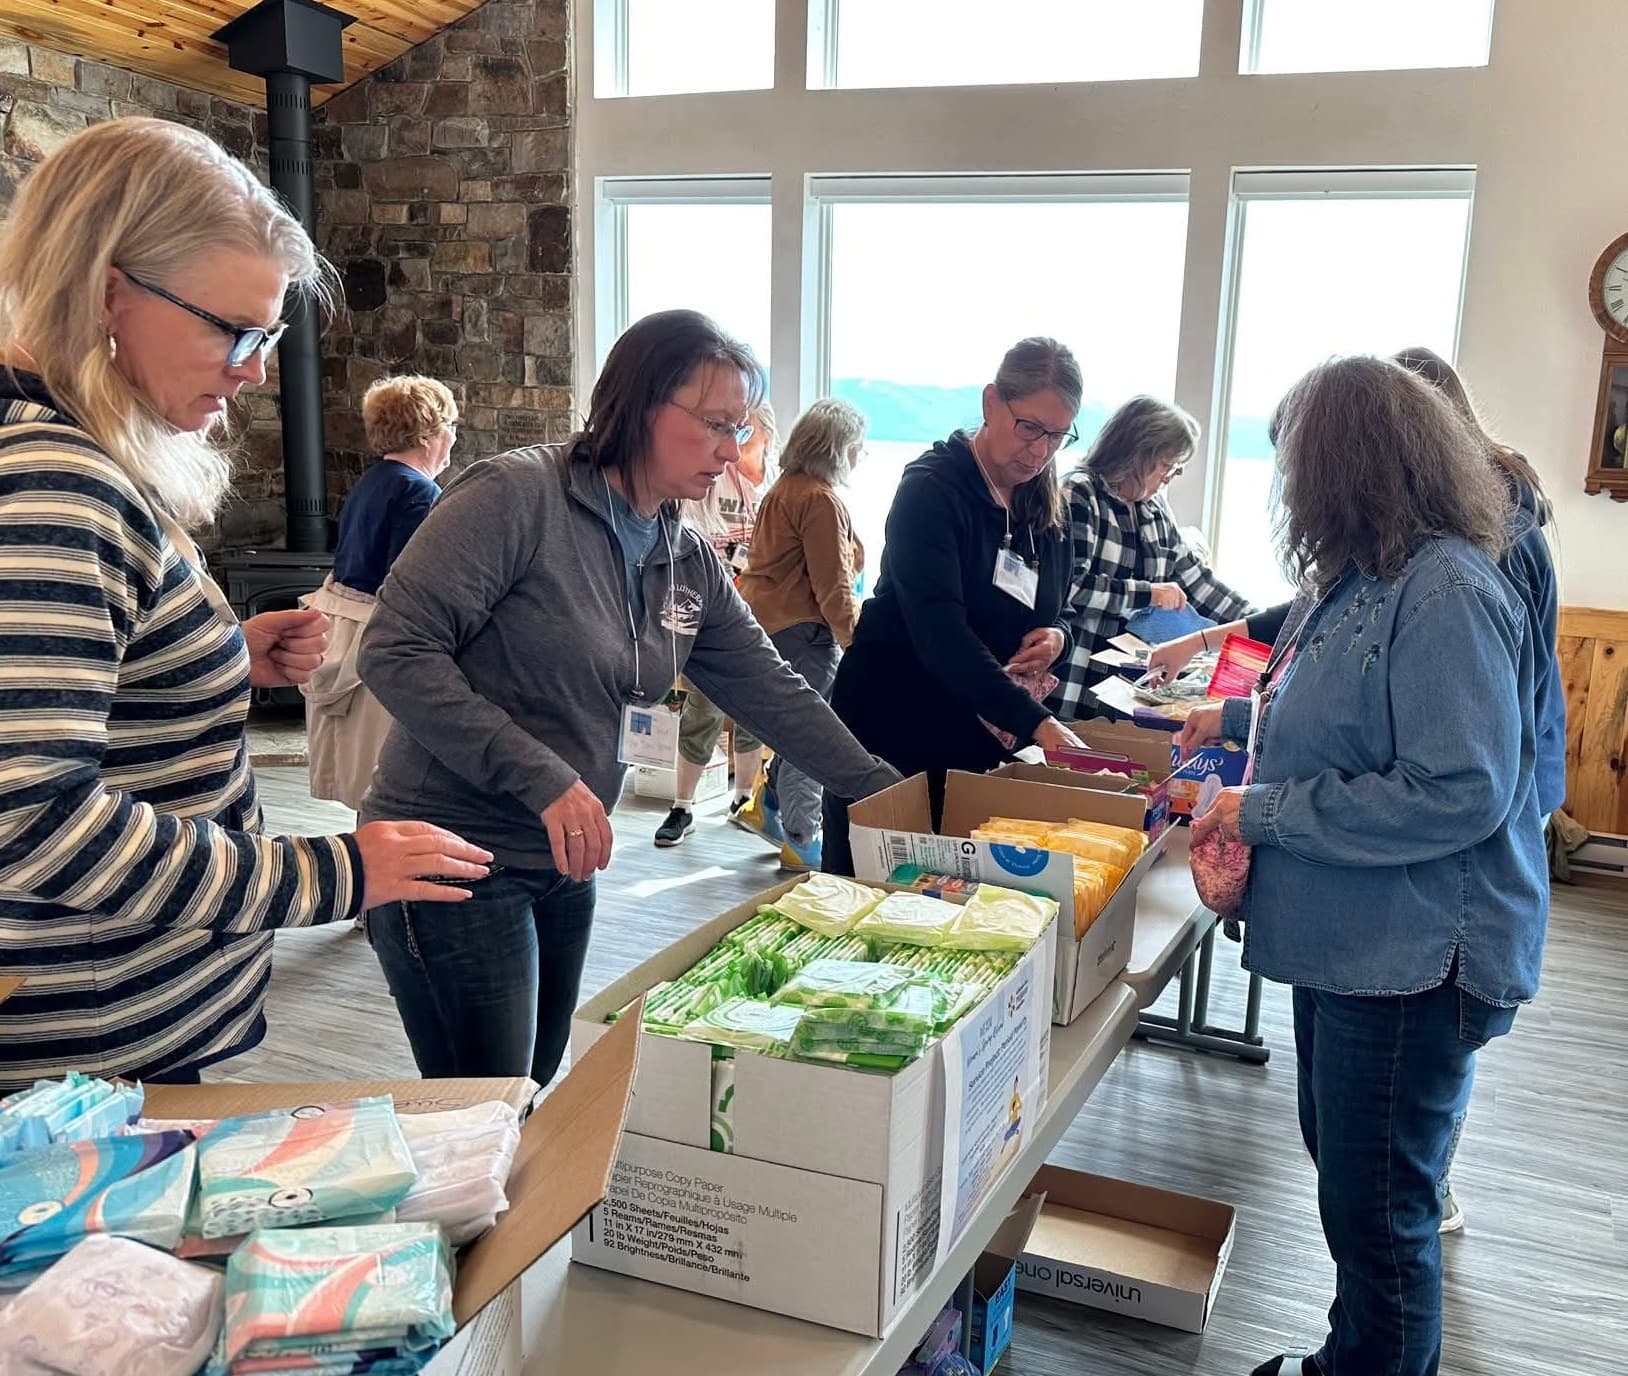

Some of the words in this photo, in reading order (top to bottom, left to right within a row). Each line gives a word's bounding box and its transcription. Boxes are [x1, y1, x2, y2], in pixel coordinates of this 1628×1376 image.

[665, 1171, 692, 1187] Copy
[694, 1177, 724, 1192] Paper
[634, 1176, 712, 1203] Reprographique
[723, 1197, 756, 1214] Usage
[758, 1205, 798, 1223] Multiple
[647, 1192, 676, 1208] Copia
[603, 1207, 609, 1216] 5
[611, 1209, 718, 1242] Reams/Rames/Resmas
[629, 1203, 729, 1234] Sheets/Feuilles/Hojas
[603, 1228, 615, 1238] 20
[616, 1231, 625, 1241] lb
[627, 1234, 715, 1263] Weight/Poids/Peso
[604, 1218, 612, 1227] 11
[615, 1220, 624, 1230] in
[626, 1222, 633, 1232] X
[634, 1225, 644, 1235] 17
[646, 1229, 675, 1242] in/279
[676, 1237, 694, 1247] mm
[696, 1240, 703, 1250] X
[705, 1243, 723, 1255] 432
[603, 1238, 615, 1248] 92
[617, 1241, 750, 1282] Brightness/Brillance/Brillante
[1015, 1260, 1053, 1281] one
[1055, 1269, 1142, 1304] universal
